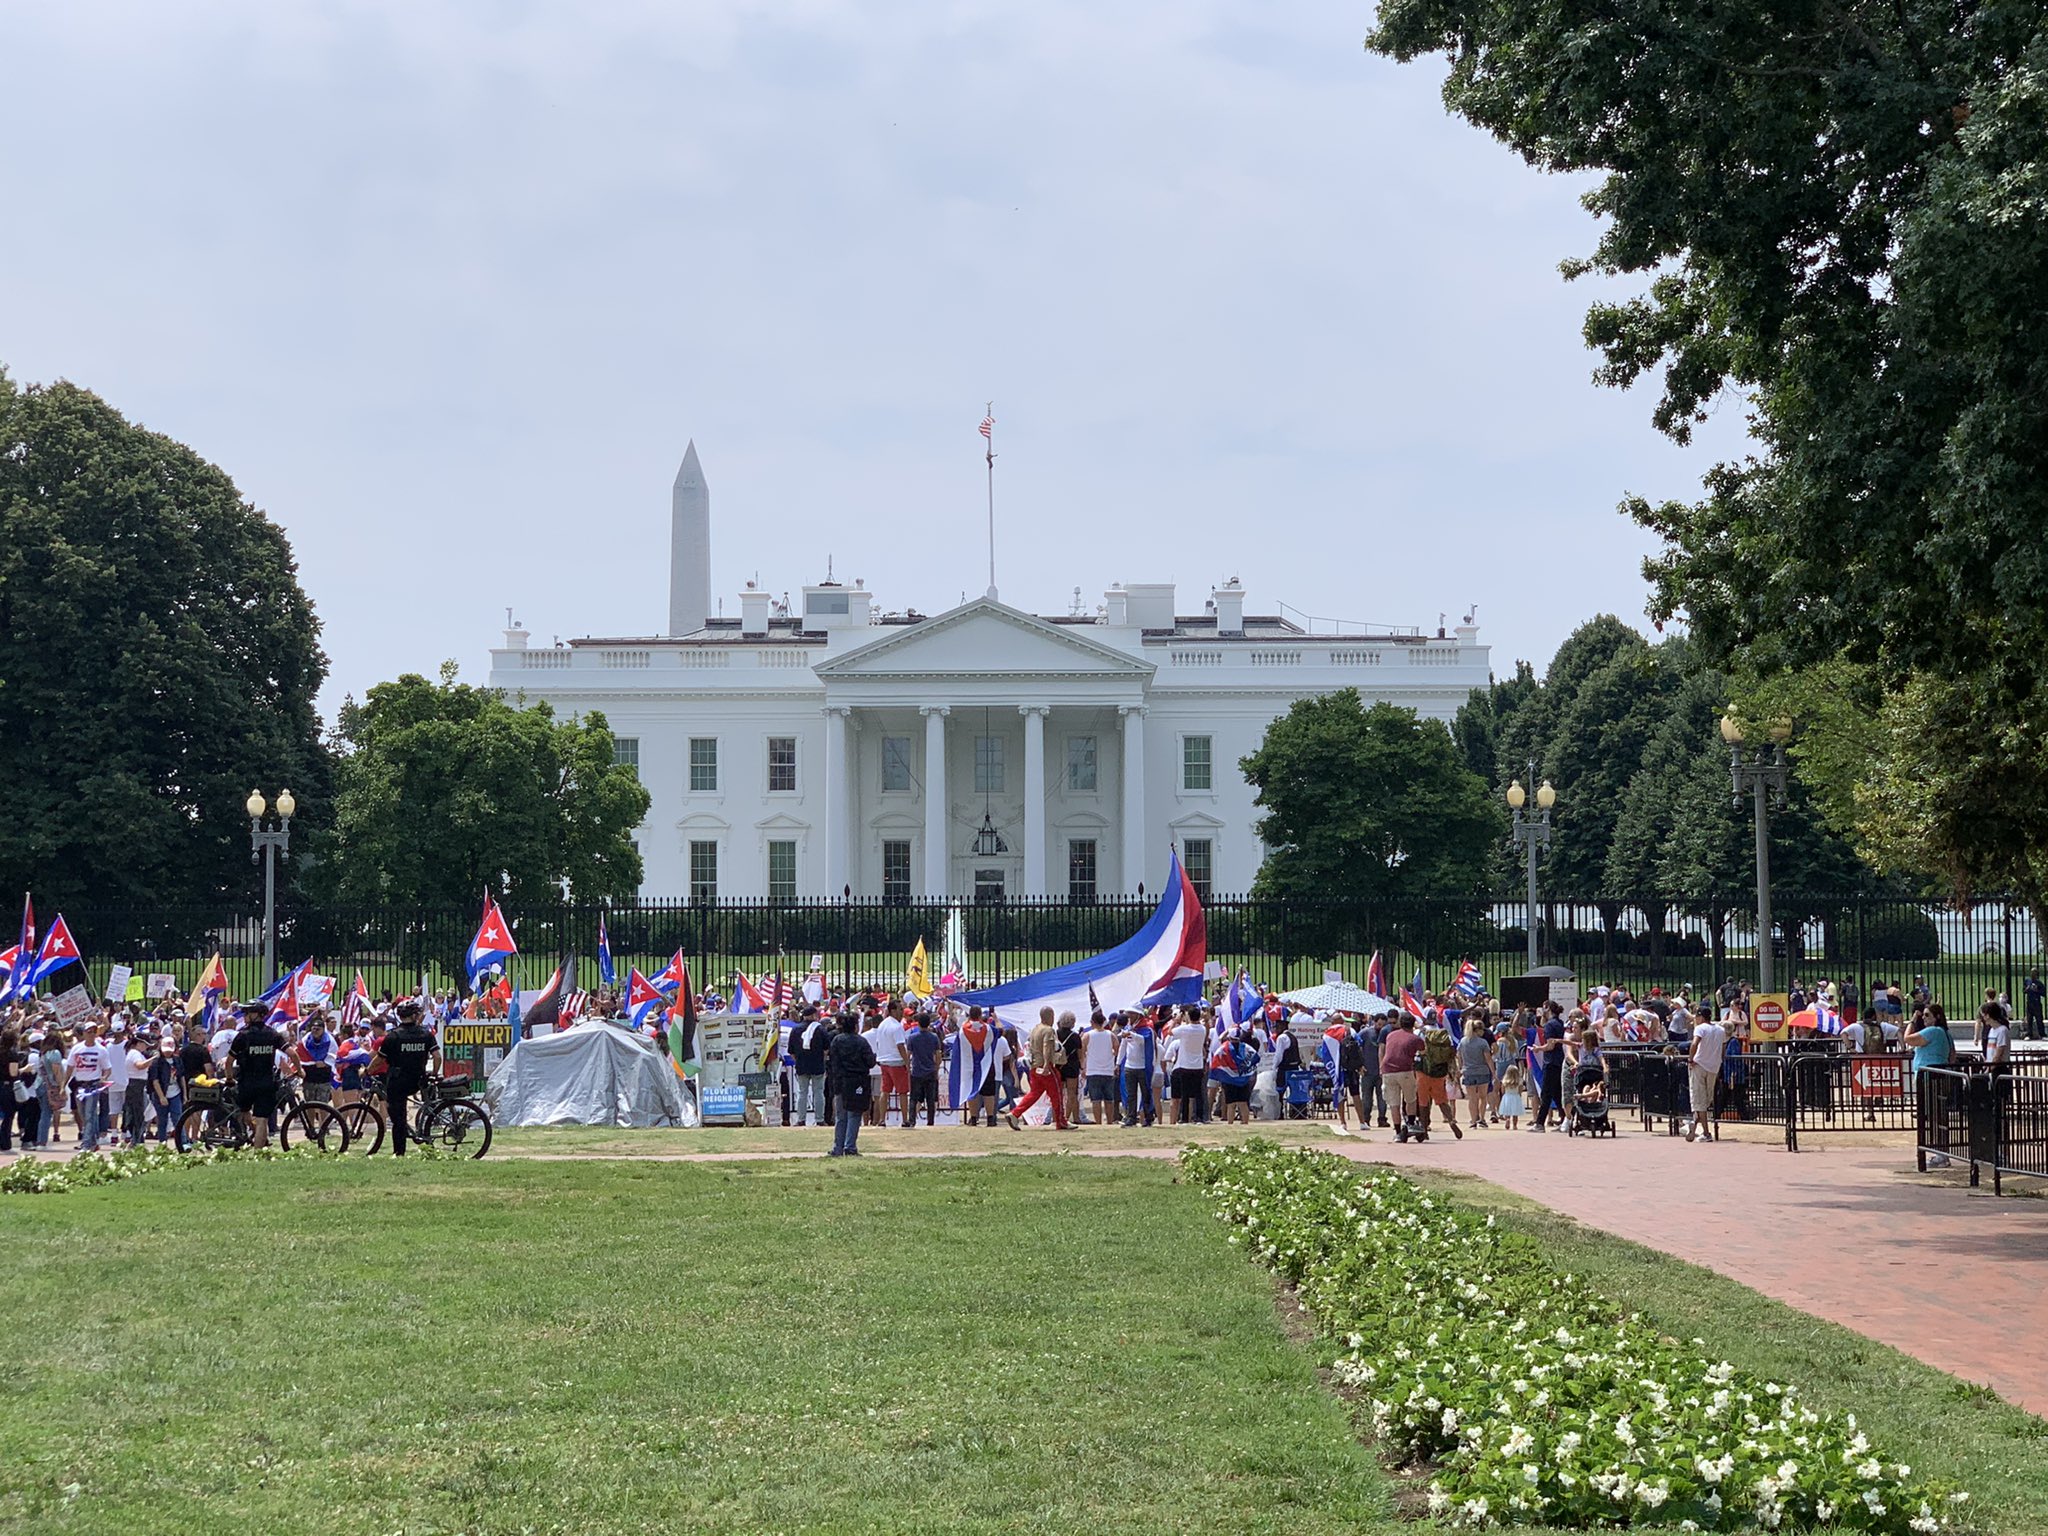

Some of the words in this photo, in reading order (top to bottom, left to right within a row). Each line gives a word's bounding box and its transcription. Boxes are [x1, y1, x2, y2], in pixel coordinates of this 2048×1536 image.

[444, 1026, 513, 1045] CONVERT
[249, 1045, 274, 1055] POLICE
[401, 1043, 426, 1052] POLICE
[445, 1046, 474, 1060] THE
[704, 1095, 744, 1103] NEIGHBOR
